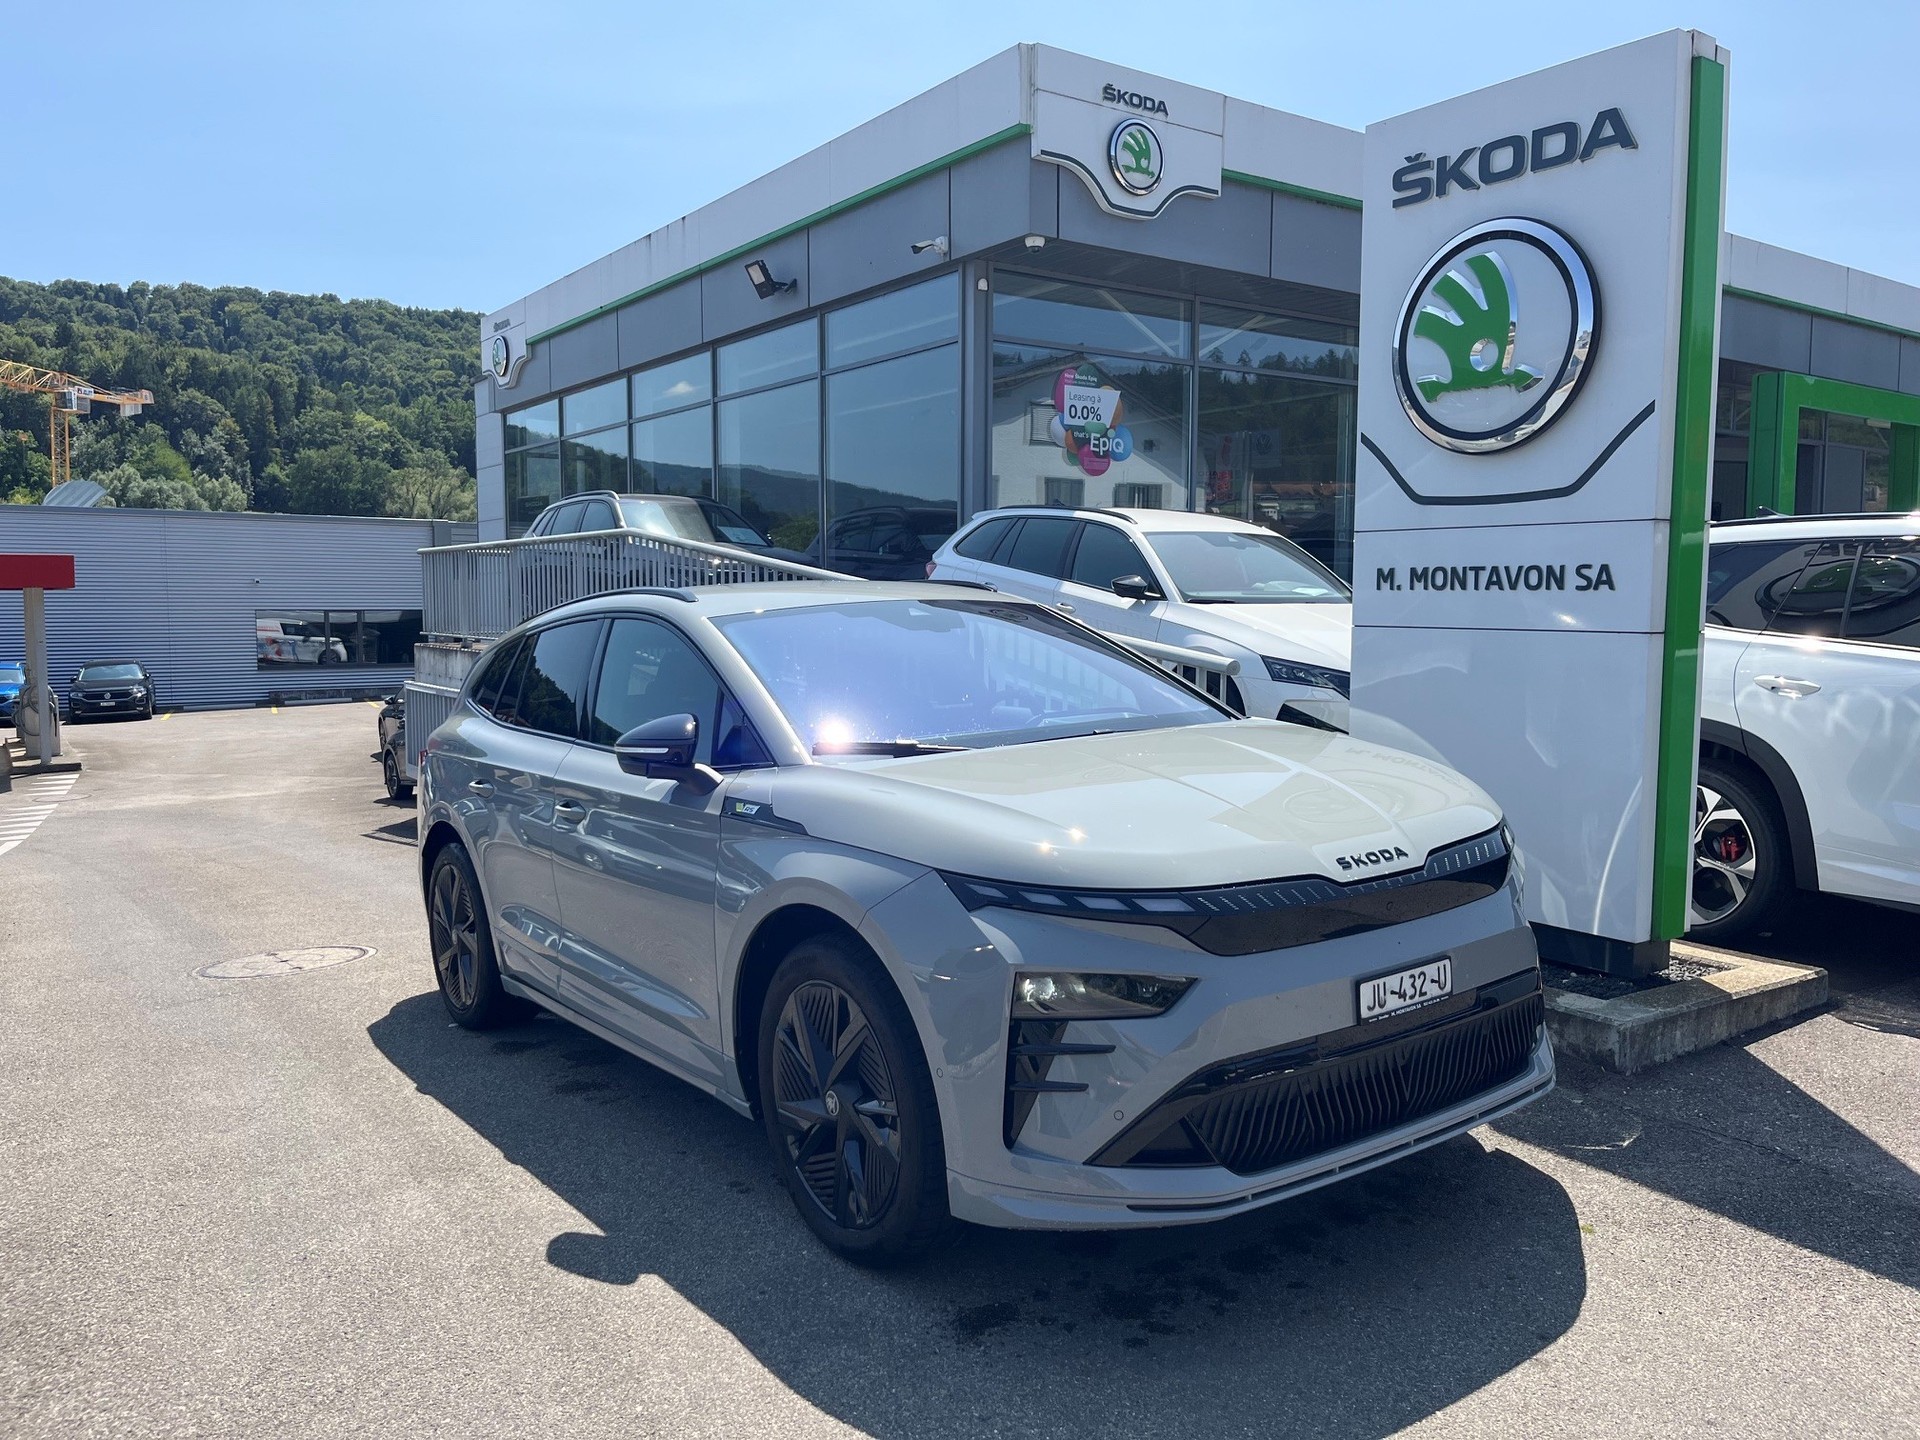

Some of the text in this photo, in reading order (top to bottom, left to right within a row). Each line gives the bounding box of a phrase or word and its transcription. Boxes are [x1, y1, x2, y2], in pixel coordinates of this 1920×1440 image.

[1102, 83, 1169, 118] ŠKODA
[1392, 107, 1638, 209] ŠKODA
[1069, 392, 1096, 404] Leasing
[1069, 404, 1102, 421] 0.0%
[1376, 563, 1615, 591] M. MONTAVON SA
